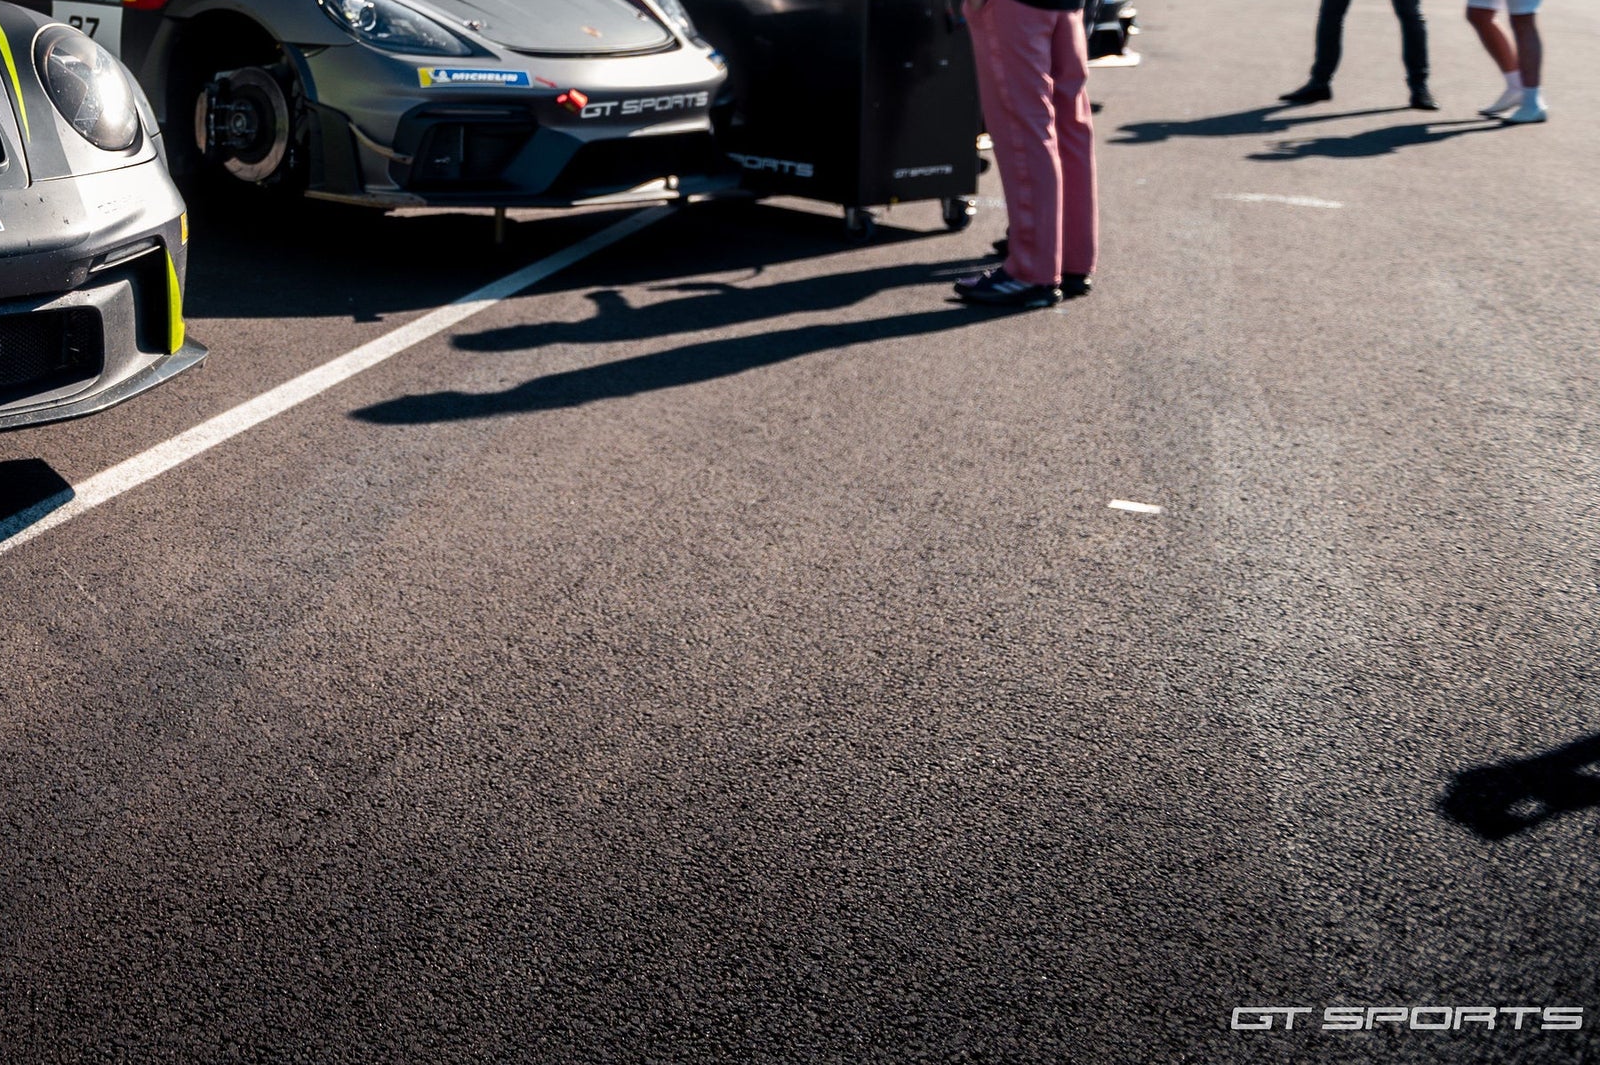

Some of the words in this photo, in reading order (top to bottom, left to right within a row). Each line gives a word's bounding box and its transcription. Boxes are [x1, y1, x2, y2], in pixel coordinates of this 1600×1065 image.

[451, 72, 518, 82] MICHELIN
[580, 101, 619, 118] GT
[621, 91, 709, 115] SPORTS
